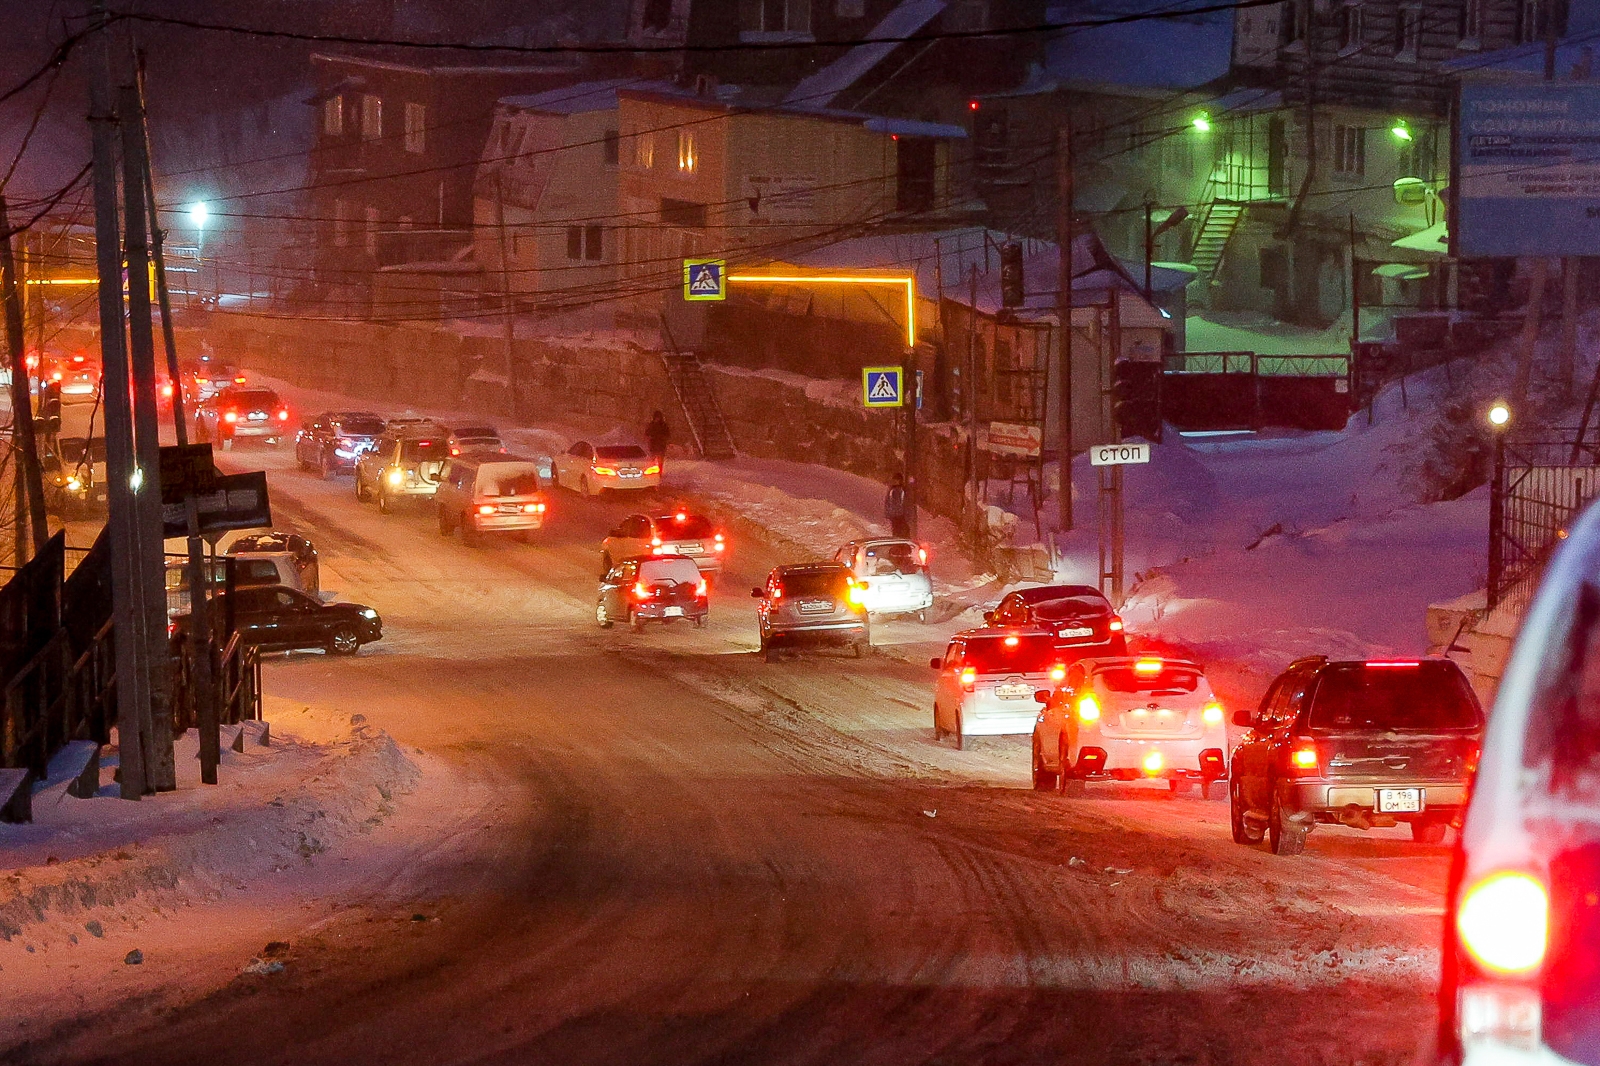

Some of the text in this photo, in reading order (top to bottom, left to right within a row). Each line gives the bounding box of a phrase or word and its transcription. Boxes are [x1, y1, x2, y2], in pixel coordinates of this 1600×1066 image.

[1099, 447, 1141, 461] СТОП
[1397, 791, 1413, 800] 198
[1385, 802, 1399, 811] ОМ
